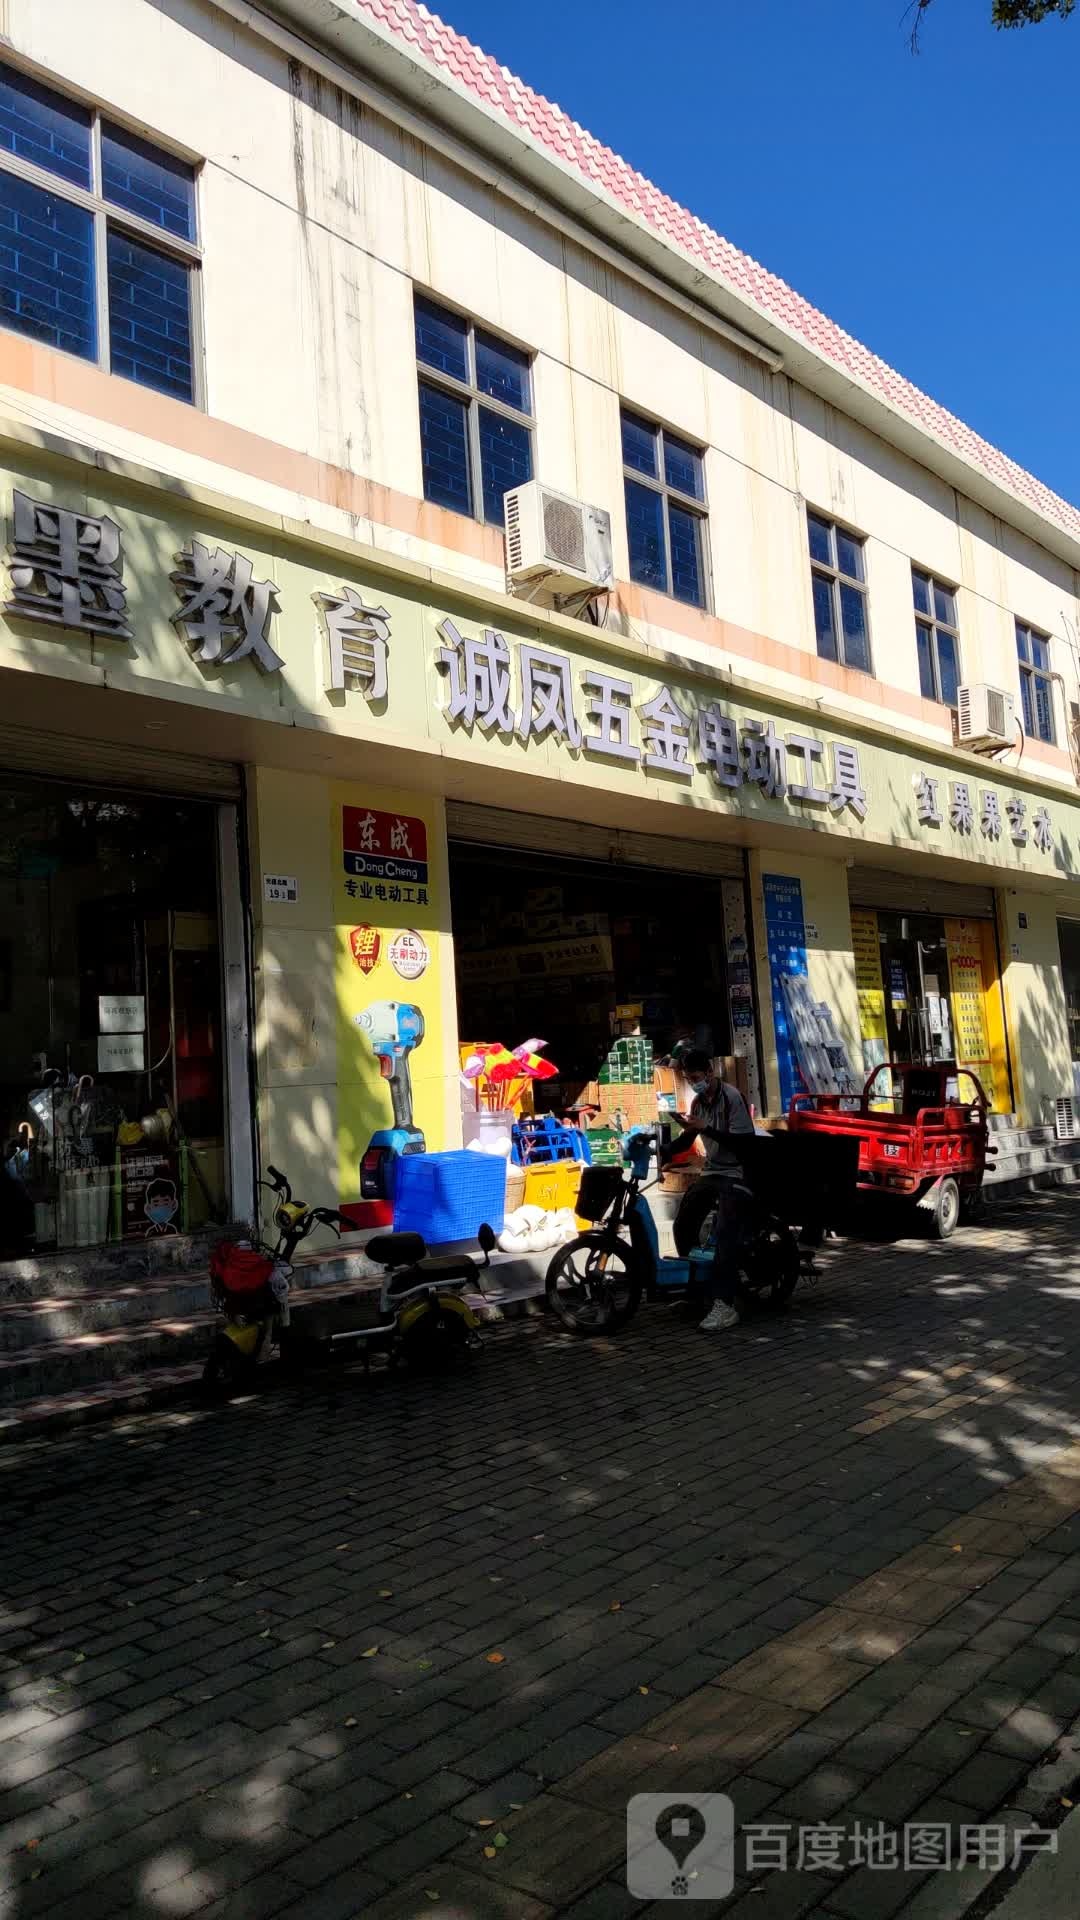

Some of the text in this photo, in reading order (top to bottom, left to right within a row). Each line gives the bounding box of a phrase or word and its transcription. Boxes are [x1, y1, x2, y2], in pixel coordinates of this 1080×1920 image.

[436, 617, 867, 818] 诚凤五金电动工具
[913, 772, 1053, 850] 红果果艺术
[358, 811, 413, 858] 东成
[344, 879, 429, 905] 专业电动工具
[354, 929, 377, 956] 锂
[390, 947, 428, 962] 无刷动力
[402, 937, 414, 947] EC
